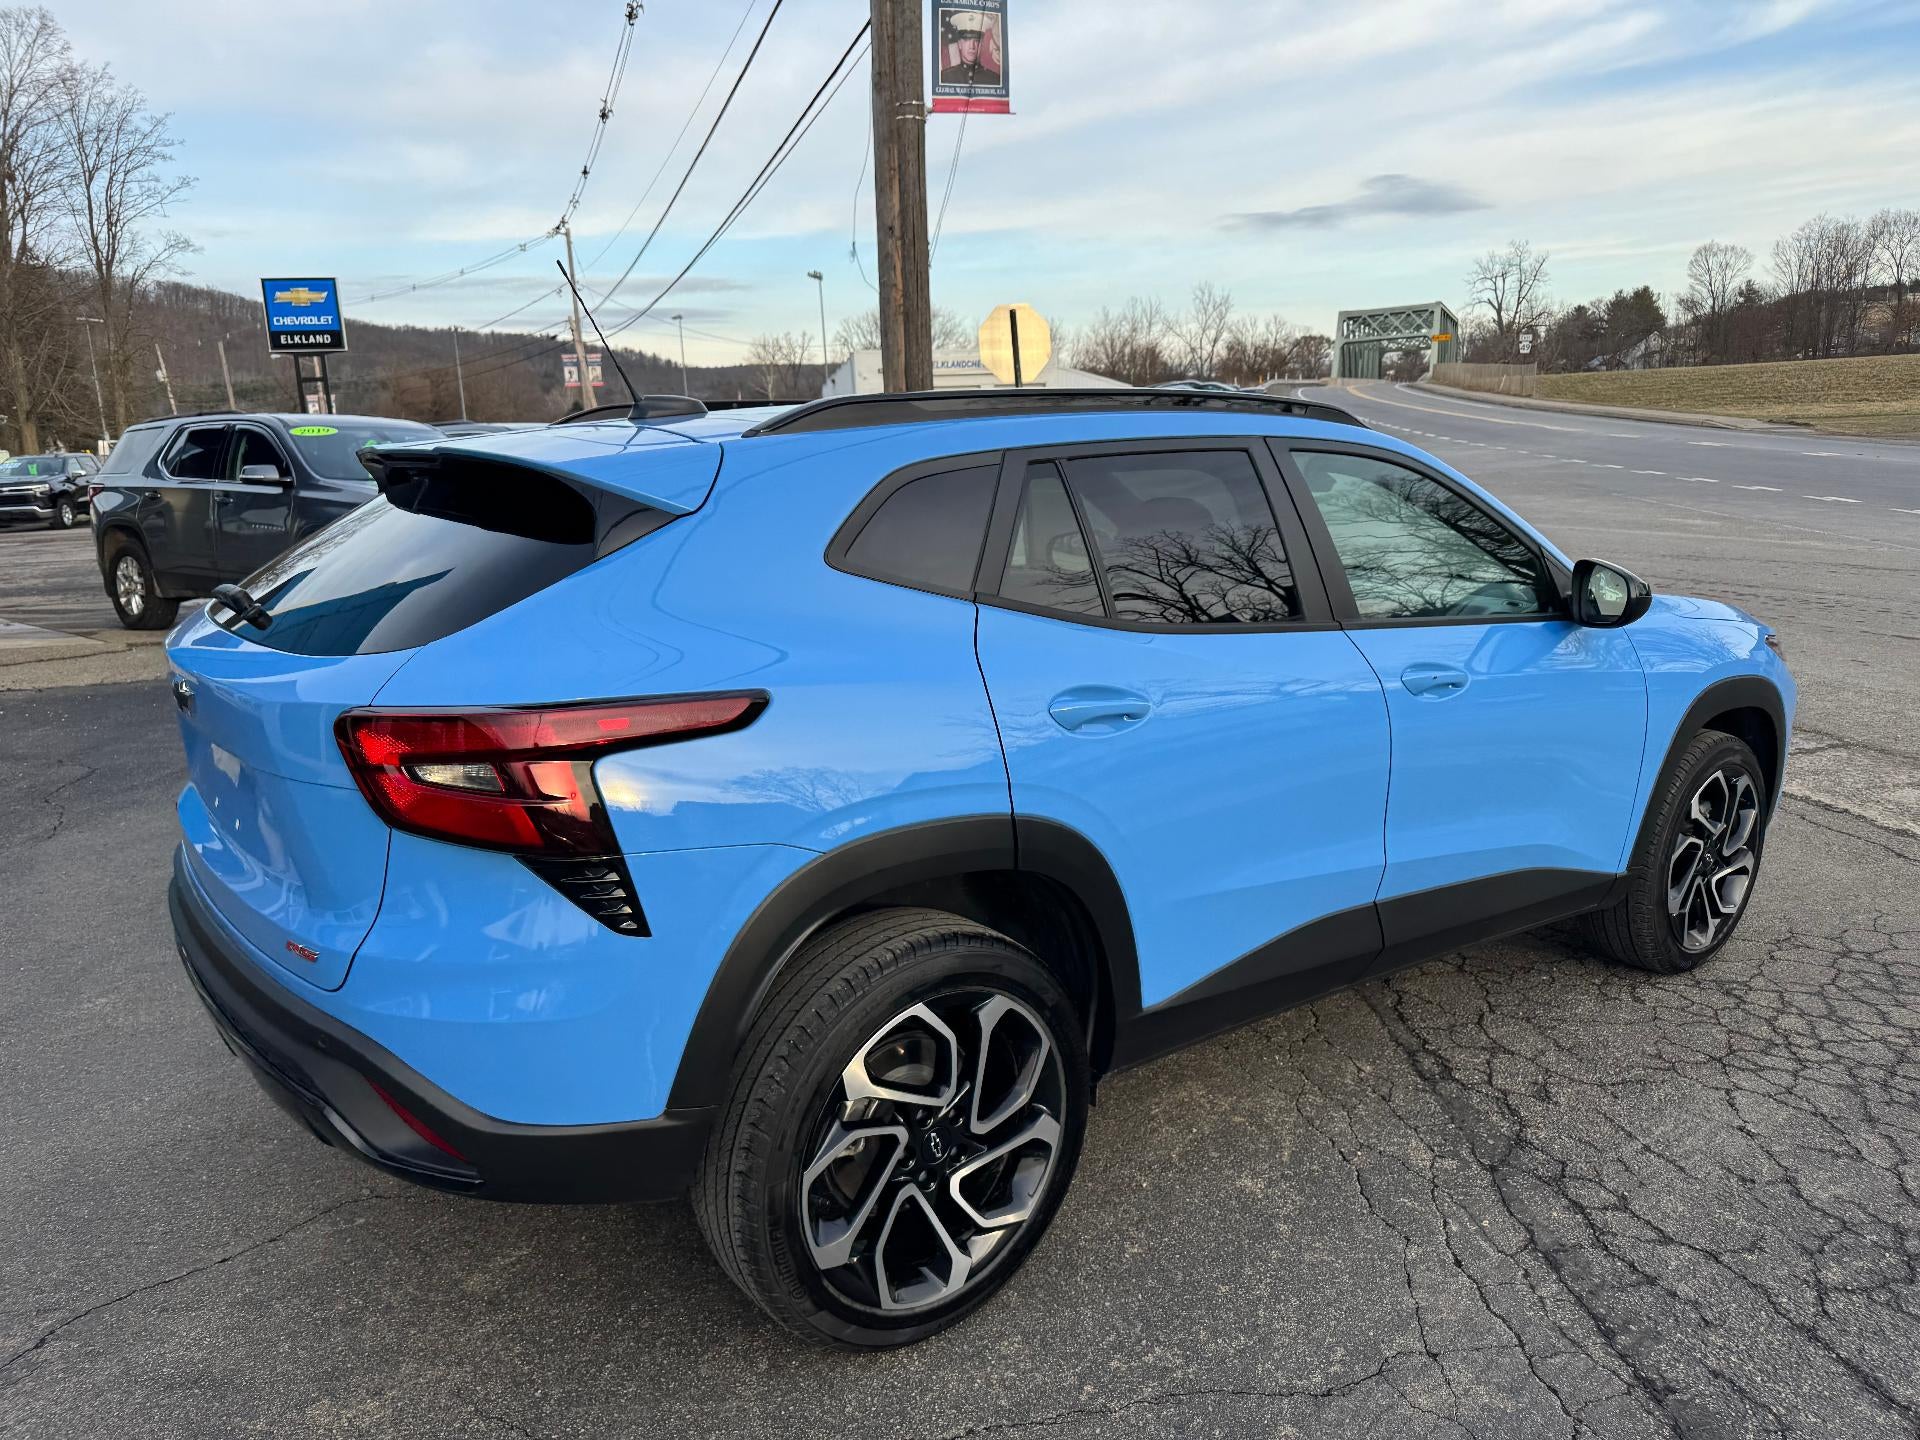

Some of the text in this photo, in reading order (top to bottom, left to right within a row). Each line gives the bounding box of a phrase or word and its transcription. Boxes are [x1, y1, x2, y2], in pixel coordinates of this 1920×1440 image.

[273, 316, 333, 325] CHEVROLET
[280, 334, 331, 344] ELKLAND
[932, 360, 984, 368] ELKLANDCHE
